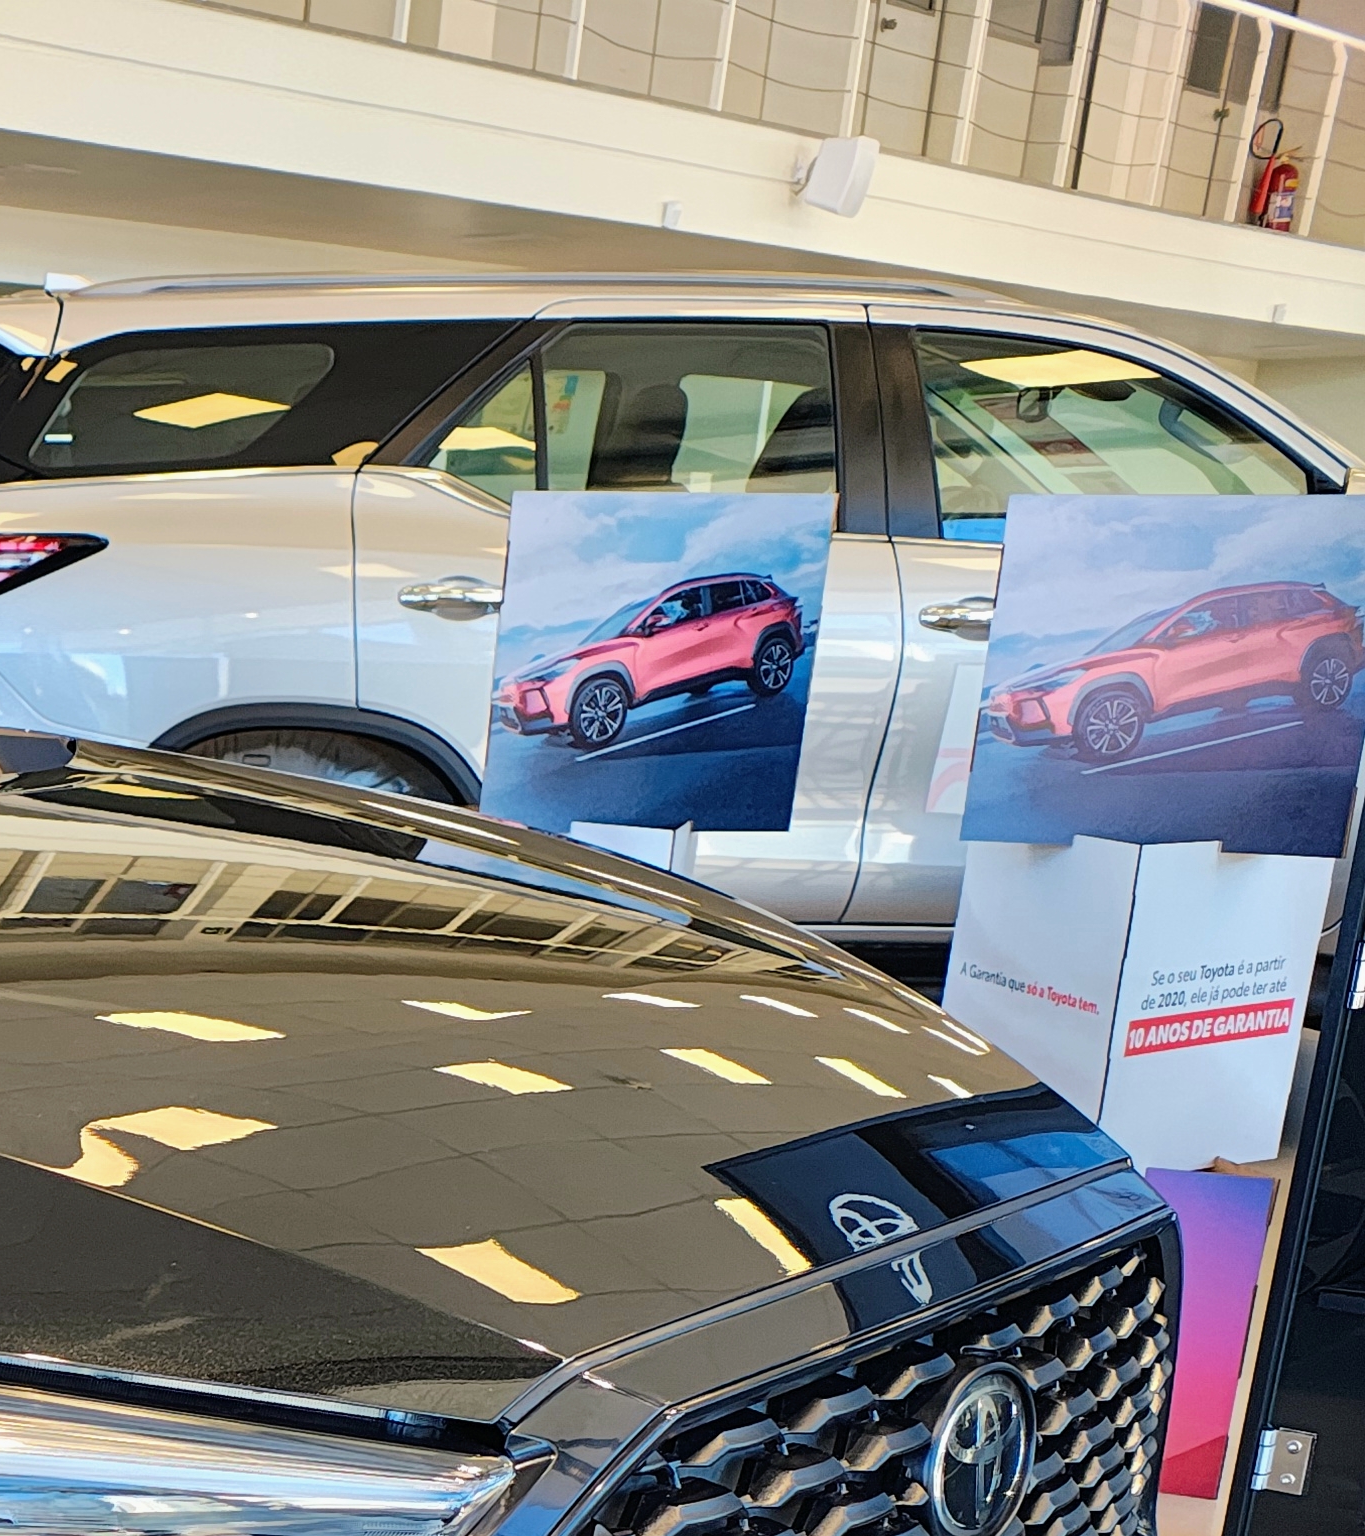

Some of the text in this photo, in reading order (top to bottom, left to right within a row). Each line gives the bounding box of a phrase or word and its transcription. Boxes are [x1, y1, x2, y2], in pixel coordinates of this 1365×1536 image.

[960, 962, 1100, 1015] A Garantia que só a Toyota tem.
[1151, 955, 1287, 987] Se o seu Toyota é a partir
[1141, 976, 1288, 1011] de 2020, ele já pode ter até
[1129, 1007, 1290, 1050] 10 ANOS DE GARANTIA
